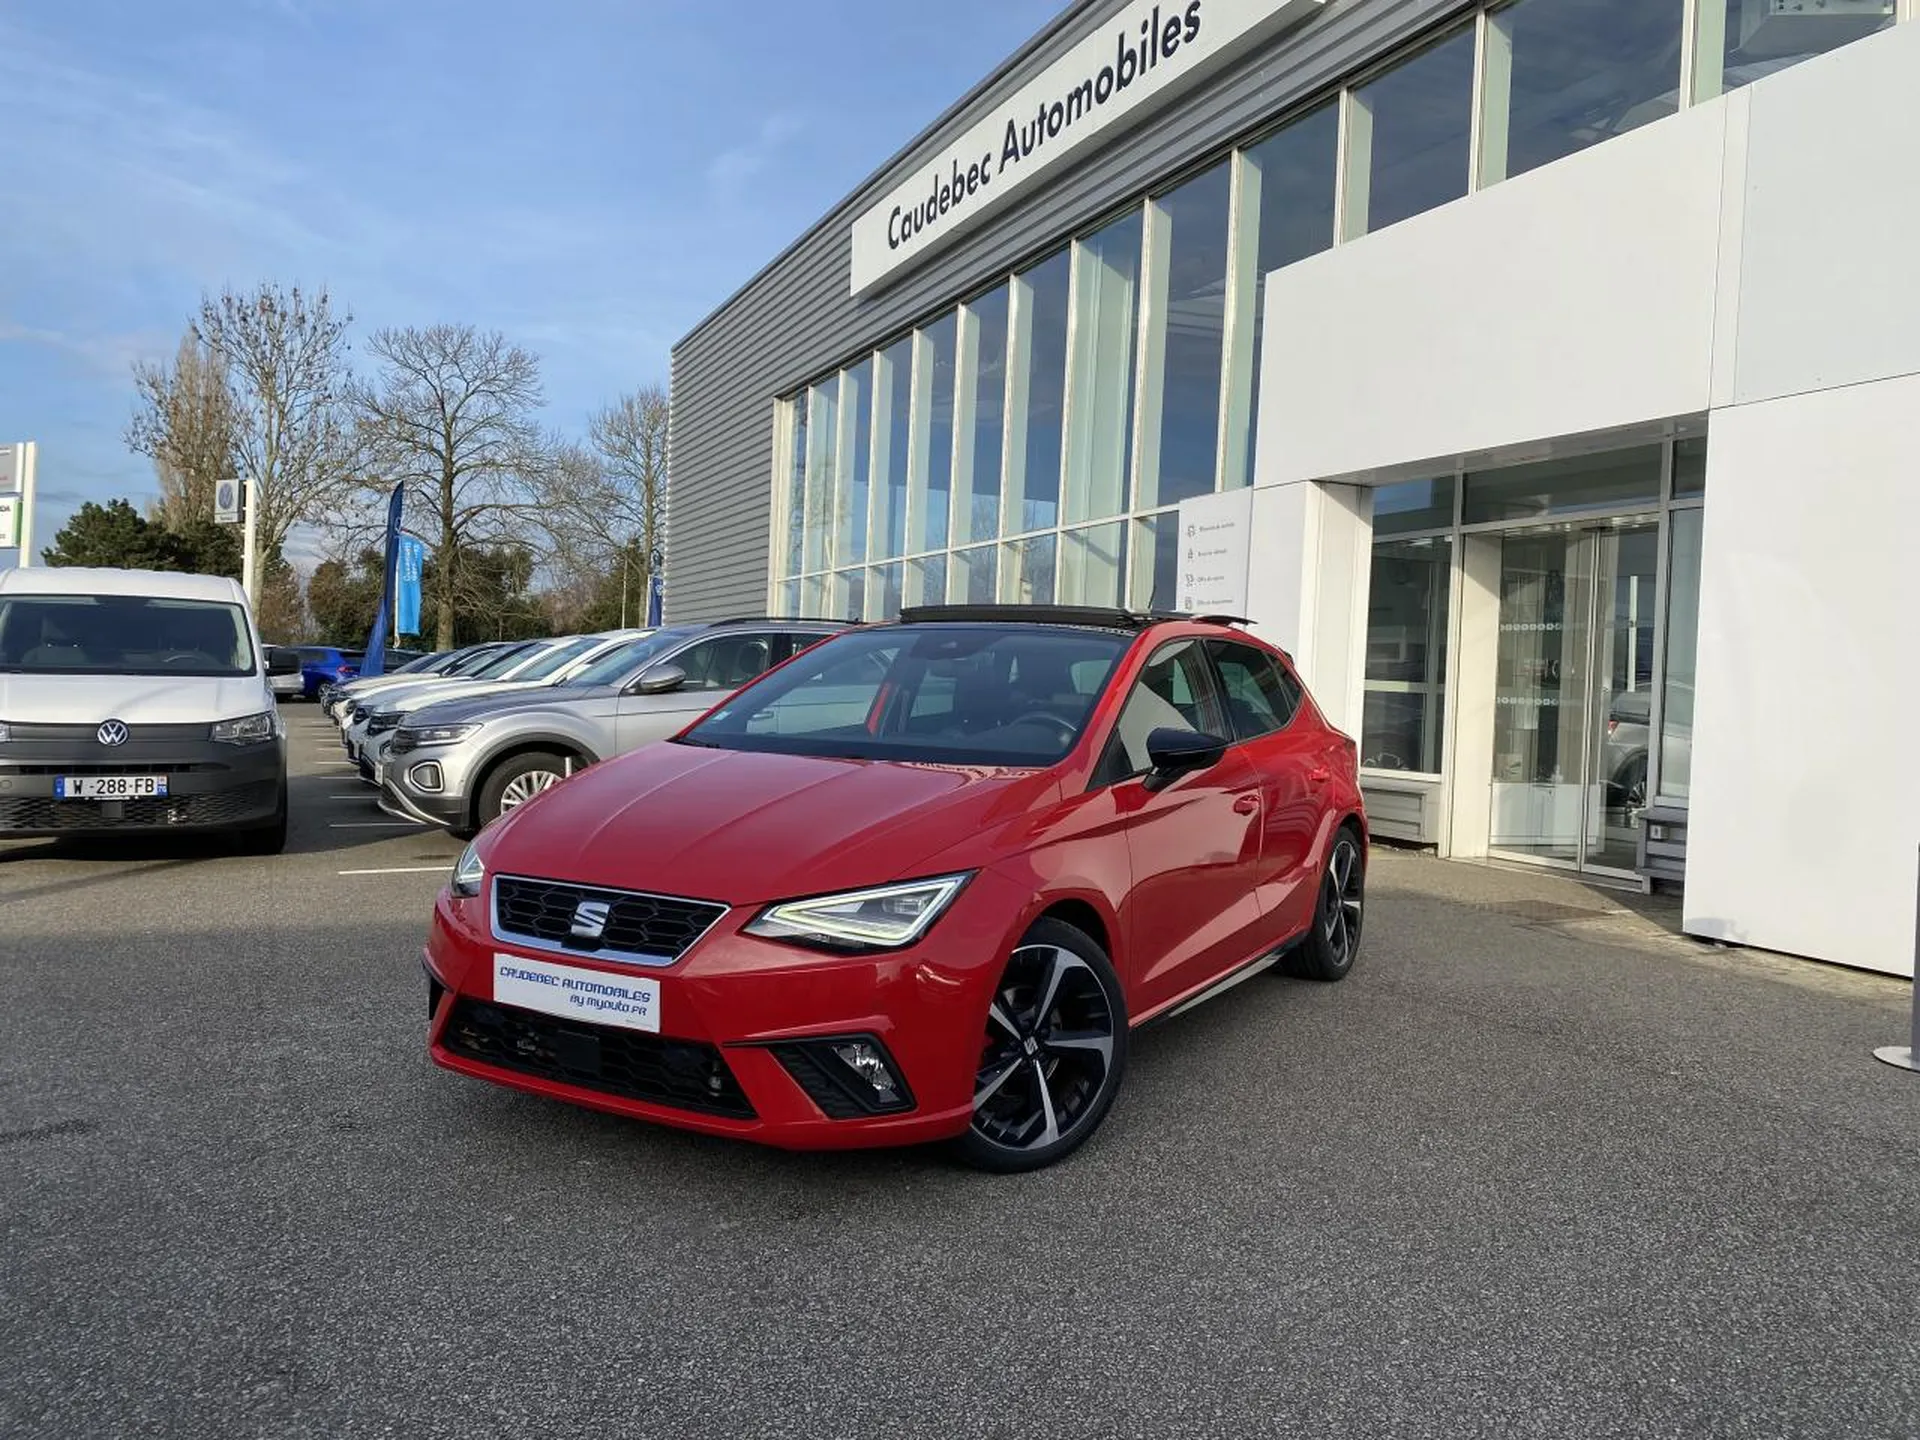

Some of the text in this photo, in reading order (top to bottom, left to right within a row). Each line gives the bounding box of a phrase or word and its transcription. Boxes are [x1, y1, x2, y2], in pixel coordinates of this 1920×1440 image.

[887, 1, 1201, 250] Caudebec Automobiles
[500, 966, 651, 1003] CAUDEBEC AUTOMOBILES
